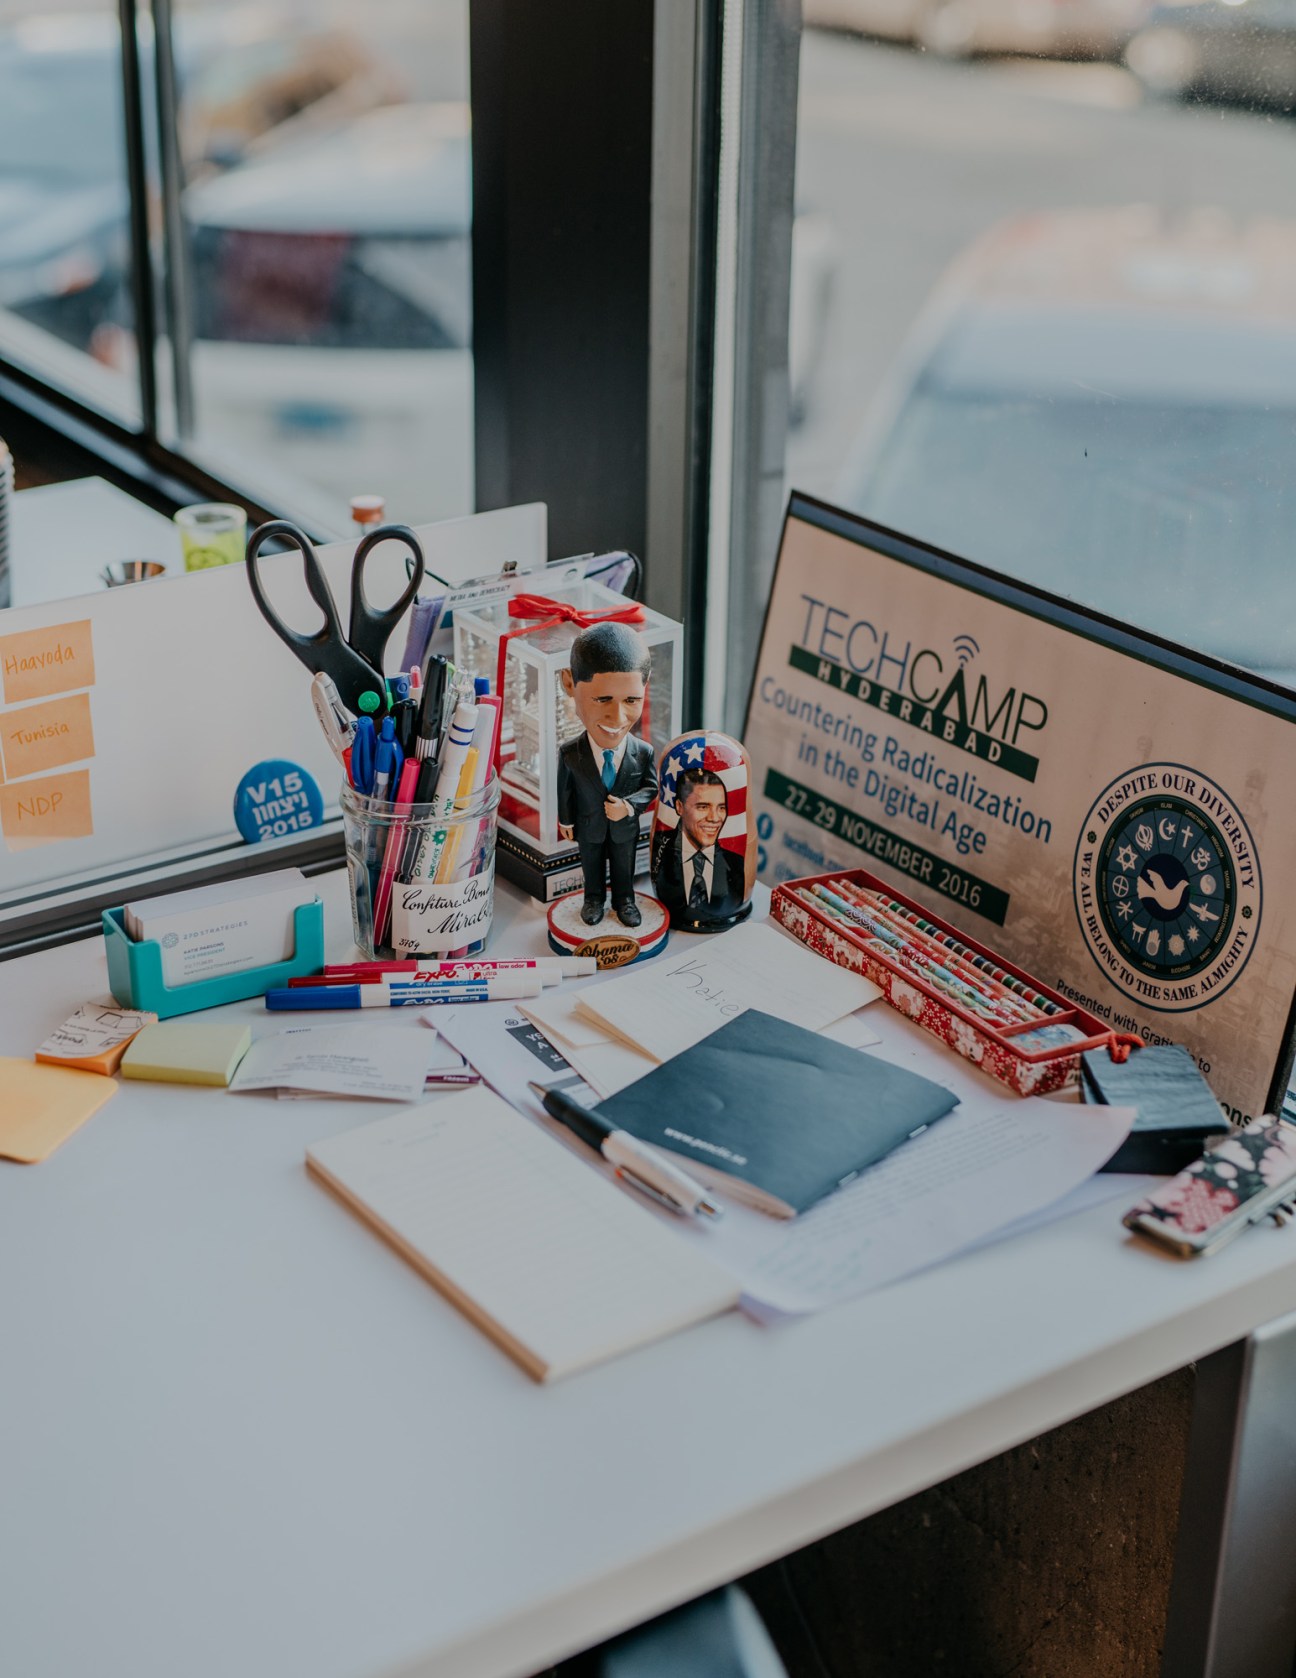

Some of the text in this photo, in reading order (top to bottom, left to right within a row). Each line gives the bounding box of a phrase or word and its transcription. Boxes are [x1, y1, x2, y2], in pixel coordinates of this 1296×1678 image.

[816, 660, 1002, 763] HYDERABAD
[10, 721, 70, 745] Tunisia
[760, 676, 1053, 844] Countering Radicalization
[245, 771, 303, 805] V15
[798, 733, 987, 855] in the Digital Age
[17, 791, 64, 822] NDP
[251, 791, 309, 825] ניצחון
[258, 810, 313, 841] 2015
[1097, 772, 1255, 889] DESPITE OUR DIVERSITY
[840, 812, 934, 883] NOVEMBER
[939, 868, 983, 908] 2016
[1081, 852, 1093, 878] WE
[402, 889, 461, 914] Confiture
[1081, 881, 1093, 913] ALL
[580, 943, 634, 958] Obama
[1086, 914, 1120, 972] BELONG
[1200, 925, 1248, 994] ALMIGHTY
[1119, 966, 1135, 986] TO
[1136, 978, 1161, 1000] THE
[1163, 984, 1198, 1001] SAME
[1056, 979, 1112, 1019] Presented
[1113, 1011, 1138, 1034] with
[1198, 1057, 1211, 1074] to
